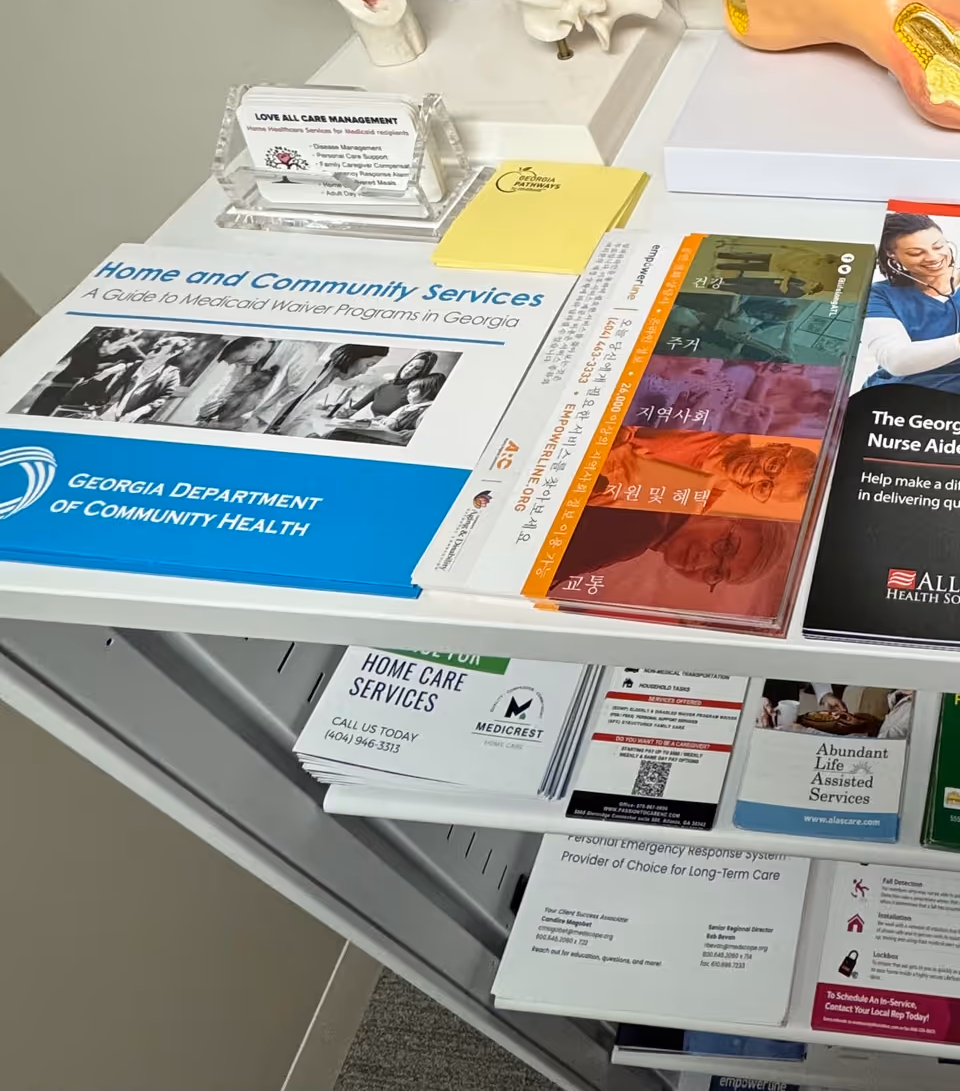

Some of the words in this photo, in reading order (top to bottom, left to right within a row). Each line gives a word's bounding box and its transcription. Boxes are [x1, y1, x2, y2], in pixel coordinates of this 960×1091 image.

[255, 113, 280, 121] LOVE
[282, 114, 299, 122] ALL
[328, 116, 398, 124] MANAGEMENT
[627, 244, 660, 300] empowerline
[93, 261, 181, 283] Home
[185, 270, 250, 287] and
[250, 272, 418, 302] Community
[422, 284, 545, 307] Services
[692, 275, 725, 291] 건강
[81, 288, 97, 299] A
[103, 289, 157, 303] Guide
[160, 293, 178, 304] to
[179, 294, 270, 310] Medicaid
[271, 300, 333, 314] Waiver
[333, 304, 418, 321] Programs
[422, 309, 440, 322] in
[443, 311, 520, 329] Georgia
[599, 317, 619, 339] (404)
[615, 319, 632, 338] 오늘
[665, 335, 702, 353] 주거
[578, 341, 606, 384] 463-3333
[593, 342, 622, 383] 당신에게
[575, 386, 601, 420] 필요한
[636, 405, 711, 425] 지역사회
[872, 410, 905, 427] The
[549, 424, 583, 472] 서비스를
[868, 433, 921, 451] Nurse
[514, 403, 576, 512] EMPOWERLINE.ORG
[861, 472, 892, 487] Help
[895, 475, 931, 489] make
[934, 481, 941, 489] a
[68, 473, 164, 496] GEORGIA
[169, 482, 324, 510] DEPARTMENT
[604, 482, 644, 503] 지원
[649, 485, 667, 503] 및
[672, 488, 712, 508] 혜택
[858, 490, 870, 500] in
[874, 491, 940, 509] delivering
[83, 500, 217, 527] COMMUNITY
[216, 513, 310, 536] HEALTH
[515, 476, 559, 544] 찾아보세요
[561, 574, 606, 595] 교통
[886, 588, 939, 604] HEALTH
[361, 653, 417, 681] HOME
[419, 666, 468, 691] CARE
[349, 677, 439, 713] SERVICES
[332, 716, 358, 730] CALL
[361, 723, 378, 733] US
[380, 726, 419, 743] TODAY
[475, 721, 545, 739] MEDICREST
[324, 729, 354, 744] (404)
[354, 735, 400, 753] 946-3313
[816, 743, 888, 759] Abundant
[814, 757, 844, 771] Life
[811, 772, 873, 788] Assisted
[809, 788, 870, 804] Services
[804, 815, 880, 826] www.alascare.com
[561, 851, 609, 867] Provider
[612, 859, 624, 869] of
[627, 860, 668, 875] Choice
[670, 864, 687, 876] for
[689, 866, 750, 881] Long-Term
[752, 869, 780, 881] Care
[825, 1002, 853, 1012] Contact
[854, 1006, 870, 1015] Your
[871, 1008, 890, 1017] Local
[891, 1011, 904, 1020] Rep
[906, 1012, 929, 1023] Today!
